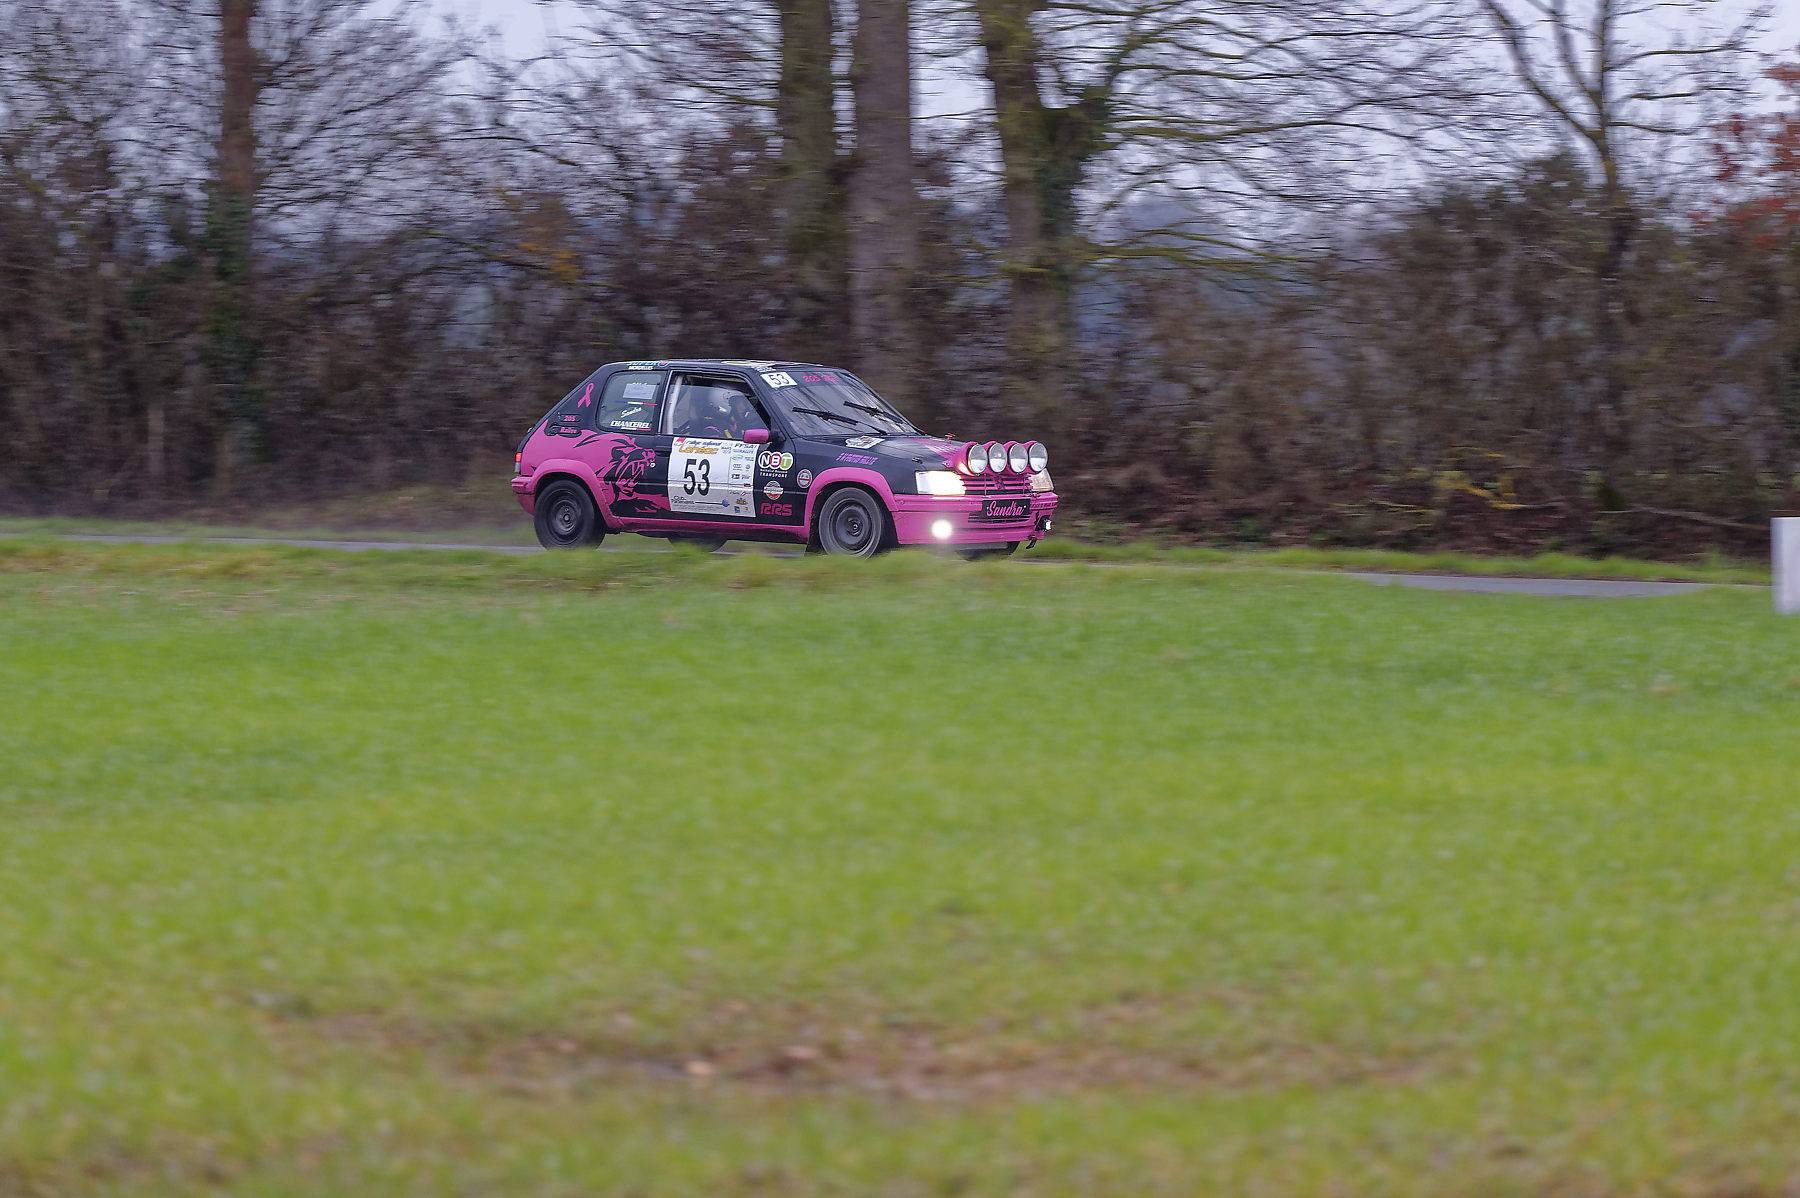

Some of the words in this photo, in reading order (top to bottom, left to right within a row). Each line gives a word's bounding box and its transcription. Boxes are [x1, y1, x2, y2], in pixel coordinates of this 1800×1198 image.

[768, 373, 790, 386] 53
[760, 453, 792, 468] NBT
[683, 459, 711, 496] 53
[760, 502, 793, 517] RRS
[986, 501, 1023, 517] Sandra
